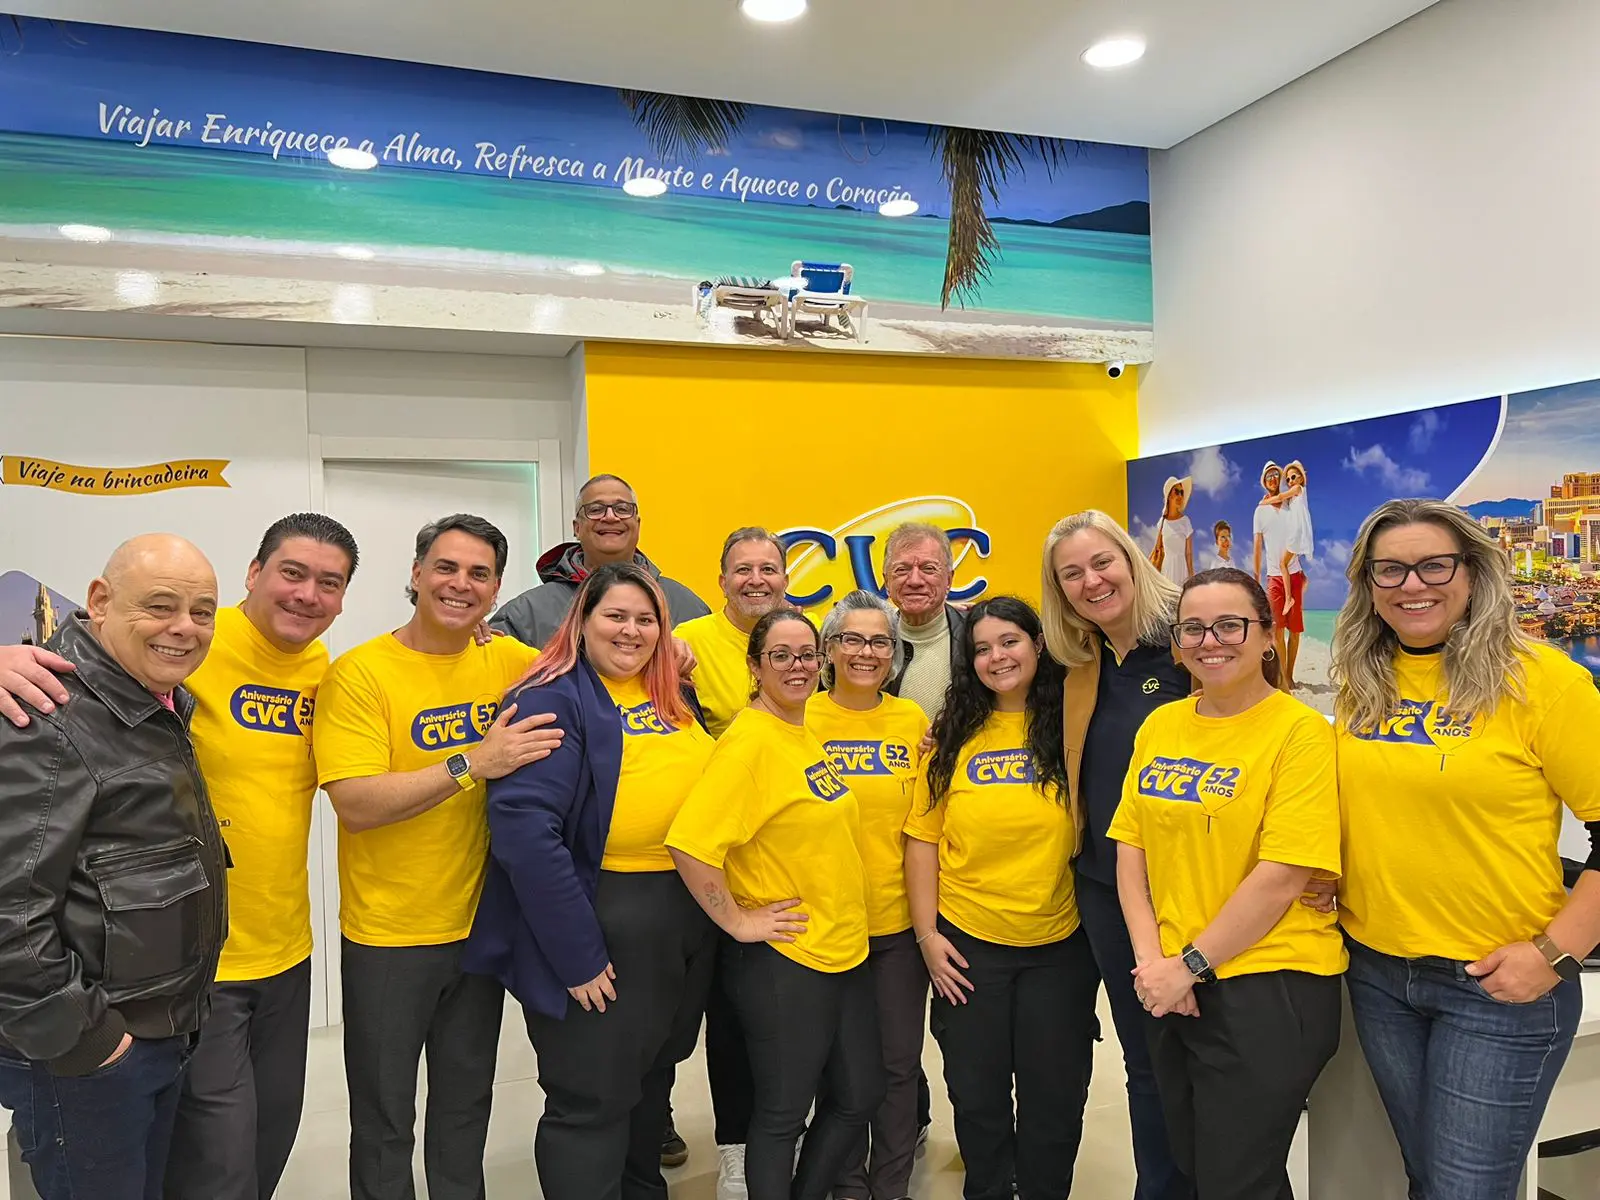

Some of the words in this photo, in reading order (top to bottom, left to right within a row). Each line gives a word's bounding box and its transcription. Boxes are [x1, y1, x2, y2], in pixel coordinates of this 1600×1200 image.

[99, 102, 192, 148] Viajar
[200, 113, 349, 160] Enriquece
[382, 131, 463, 171] Alma,
[474, 141, 584, 179] Refresca
[592, 161, 607, 180] a
[613, 156, 694, 188] Mente
[701, 172, 714, 190] e
[719, 167, 799, 203] Aquece
[806, 183, 818, 199] o
[19, 460, 65, 487] Viaje
[70, 473, 96, 488] na
[103, 464, 209, 489] brincadeira
[240, 689, 293, 706] Aniversário
[241, 700, 287, 728] CVC
[419, 710, 467, 725] Aniversário
[422, 719, 466, 746] CVC
[1431, 727, 1471, 737] ANOS
[886, 744, 910, 762] 52
[975, 753, 1029, 766] Aniversário
[889, 760, 911, 769] ANOS
[976, 761, 1025, 781] CVC
[1150, 760, 1201, 776] Aniversário
[1140, 769, 1194, 796] CVC
[1205, 767, 1241, 788] 52
[1201, 785, 1234, 798] ANOS
